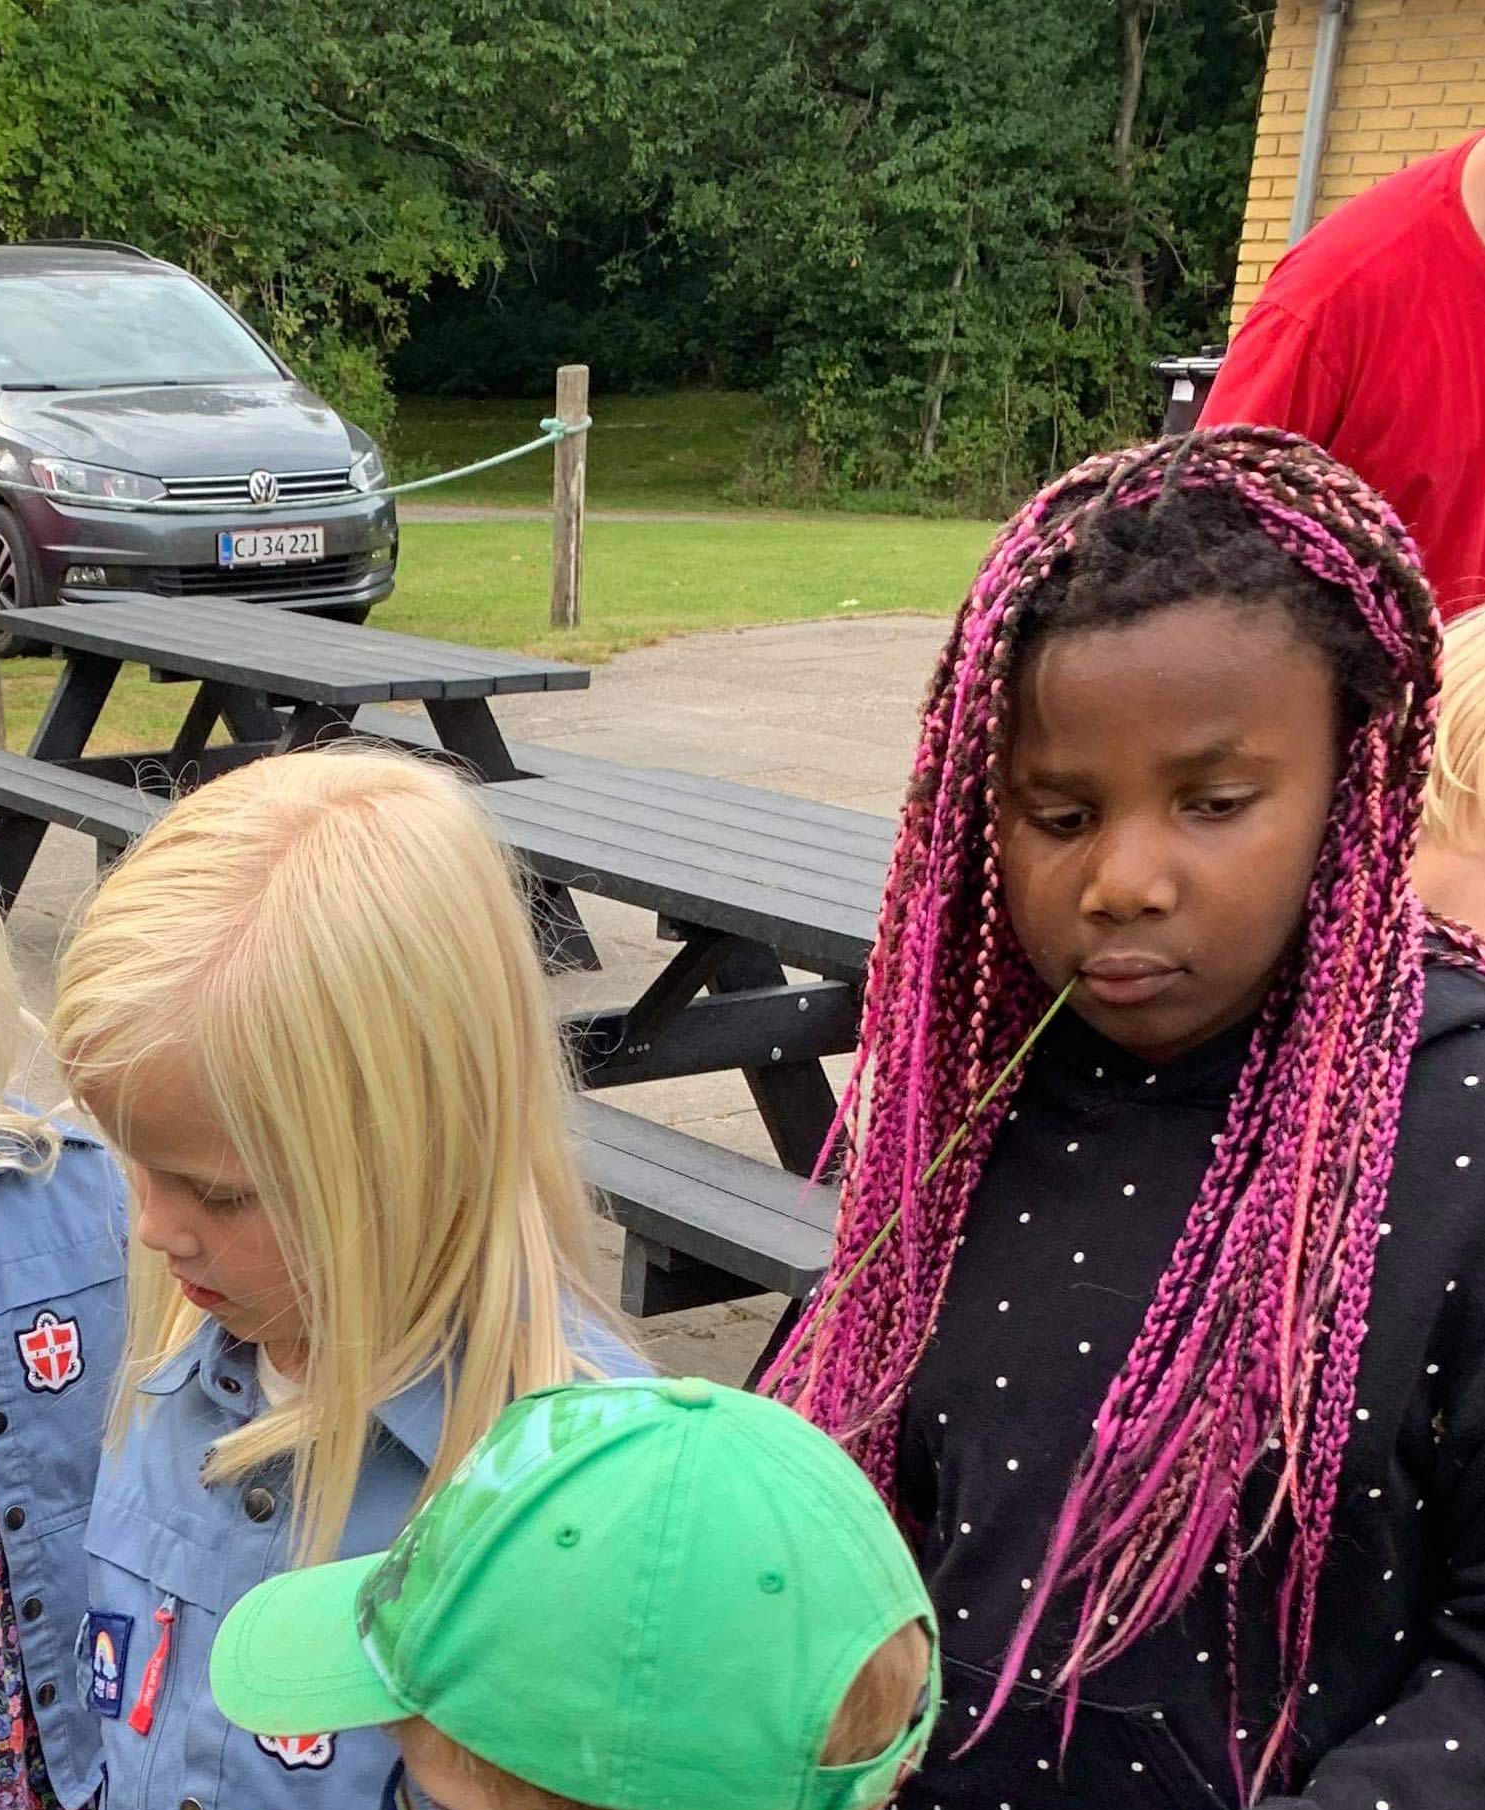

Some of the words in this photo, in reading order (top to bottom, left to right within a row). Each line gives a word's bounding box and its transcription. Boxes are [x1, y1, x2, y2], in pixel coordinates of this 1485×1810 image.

[235, 537, 257, 558] CJ
[263, 535, 284, 556] 34
[289, 533, 319, 554] 221
